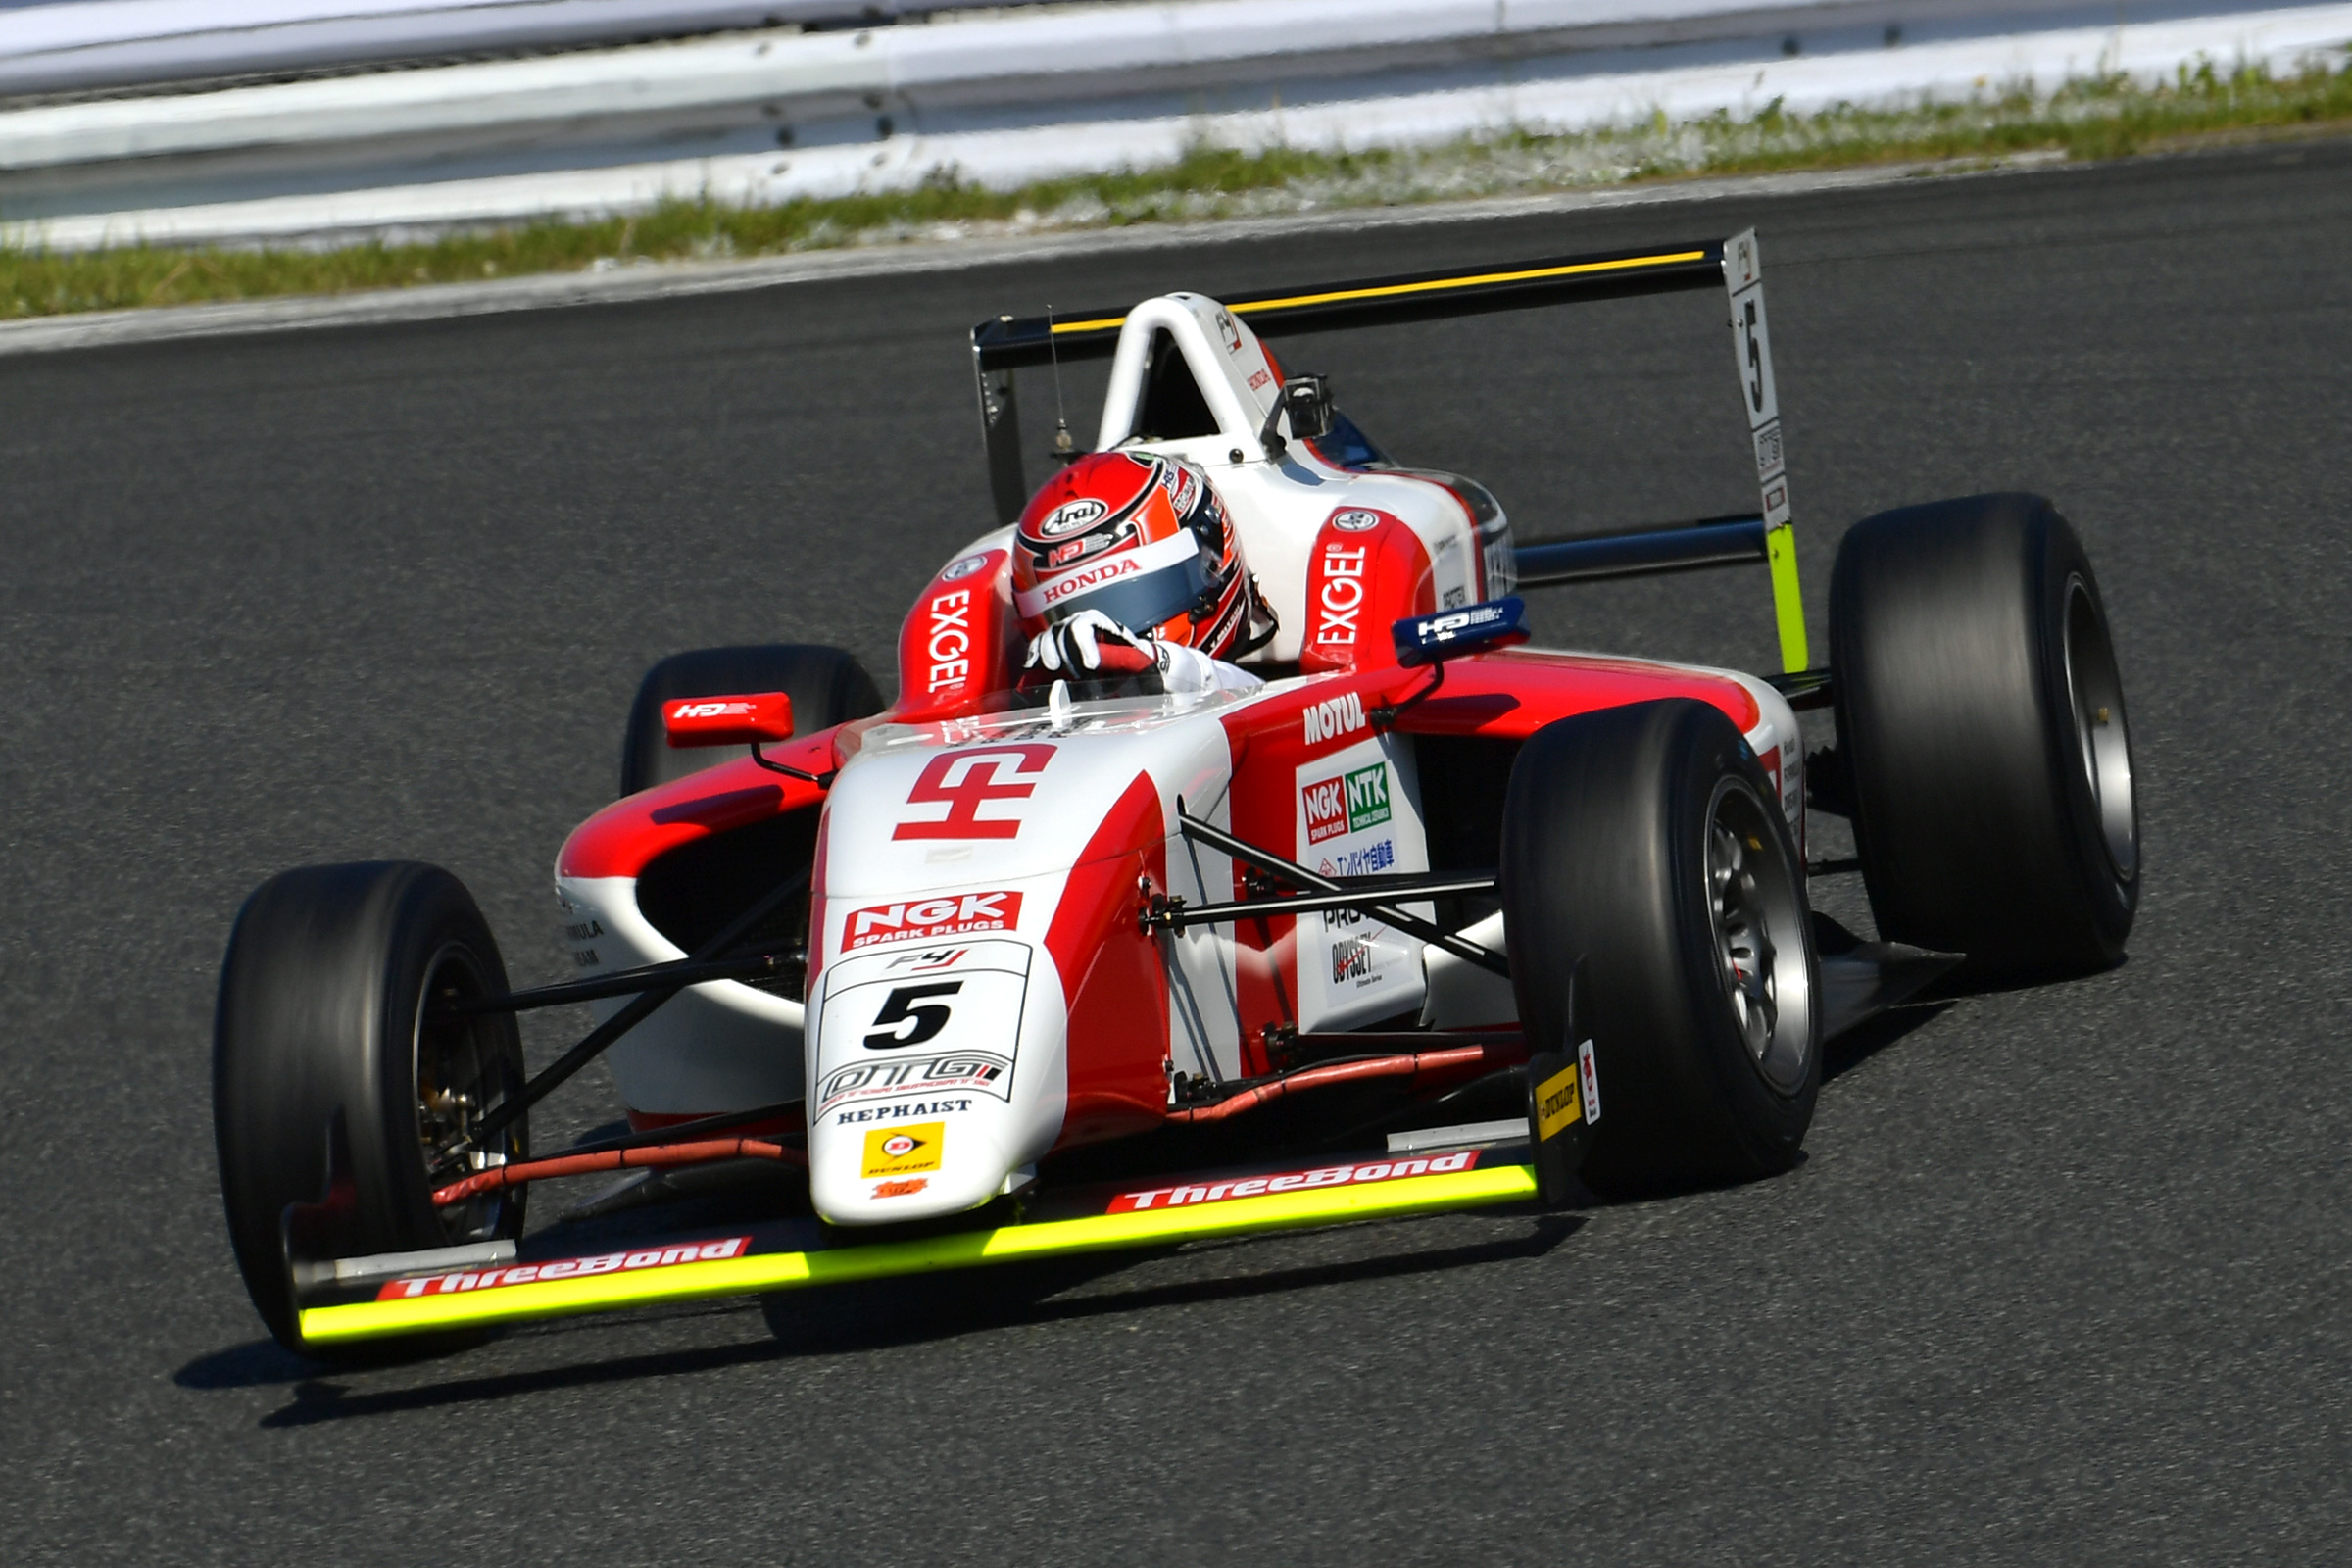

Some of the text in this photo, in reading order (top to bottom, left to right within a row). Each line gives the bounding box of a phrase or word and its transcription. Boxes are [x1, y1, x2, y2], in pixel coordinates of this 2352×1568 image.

[1744, 298, 1763, 413] 5
[1247, 368, 1271, 391] HONDA
[1048, 501, 1096, 531] Arai
[1043, 559, 1142, 603] HONDA
[1317, 547, 1365, 644] EXGEL
[928, 589, 970, 693] EXGEL
[1303, 692, 1366, 746] MOTUL
[1305, 780, 1343, 825] NGK
[1348, 766, 1387, 813] NTK
[1310, 820, 1345, 841] SPARK PLUGS
[853, 920, 1004, 948] SPARK PLUGS
[854, 893, 1008, 936] NGK
[1332, 931, 1372, 985] ODYSSEY
[863, 980, 965, 1050] 5
[837, 1100, 972, 1125] HEPHAIST
[1545, 1082, 1574, 1119] DUNLOP
[868, 1161, 934, 1174] DUNLOP
[1125, 1153, 1471, 1208] ThreeBond
[397, 1238, 744, 1297] ThreeBond
